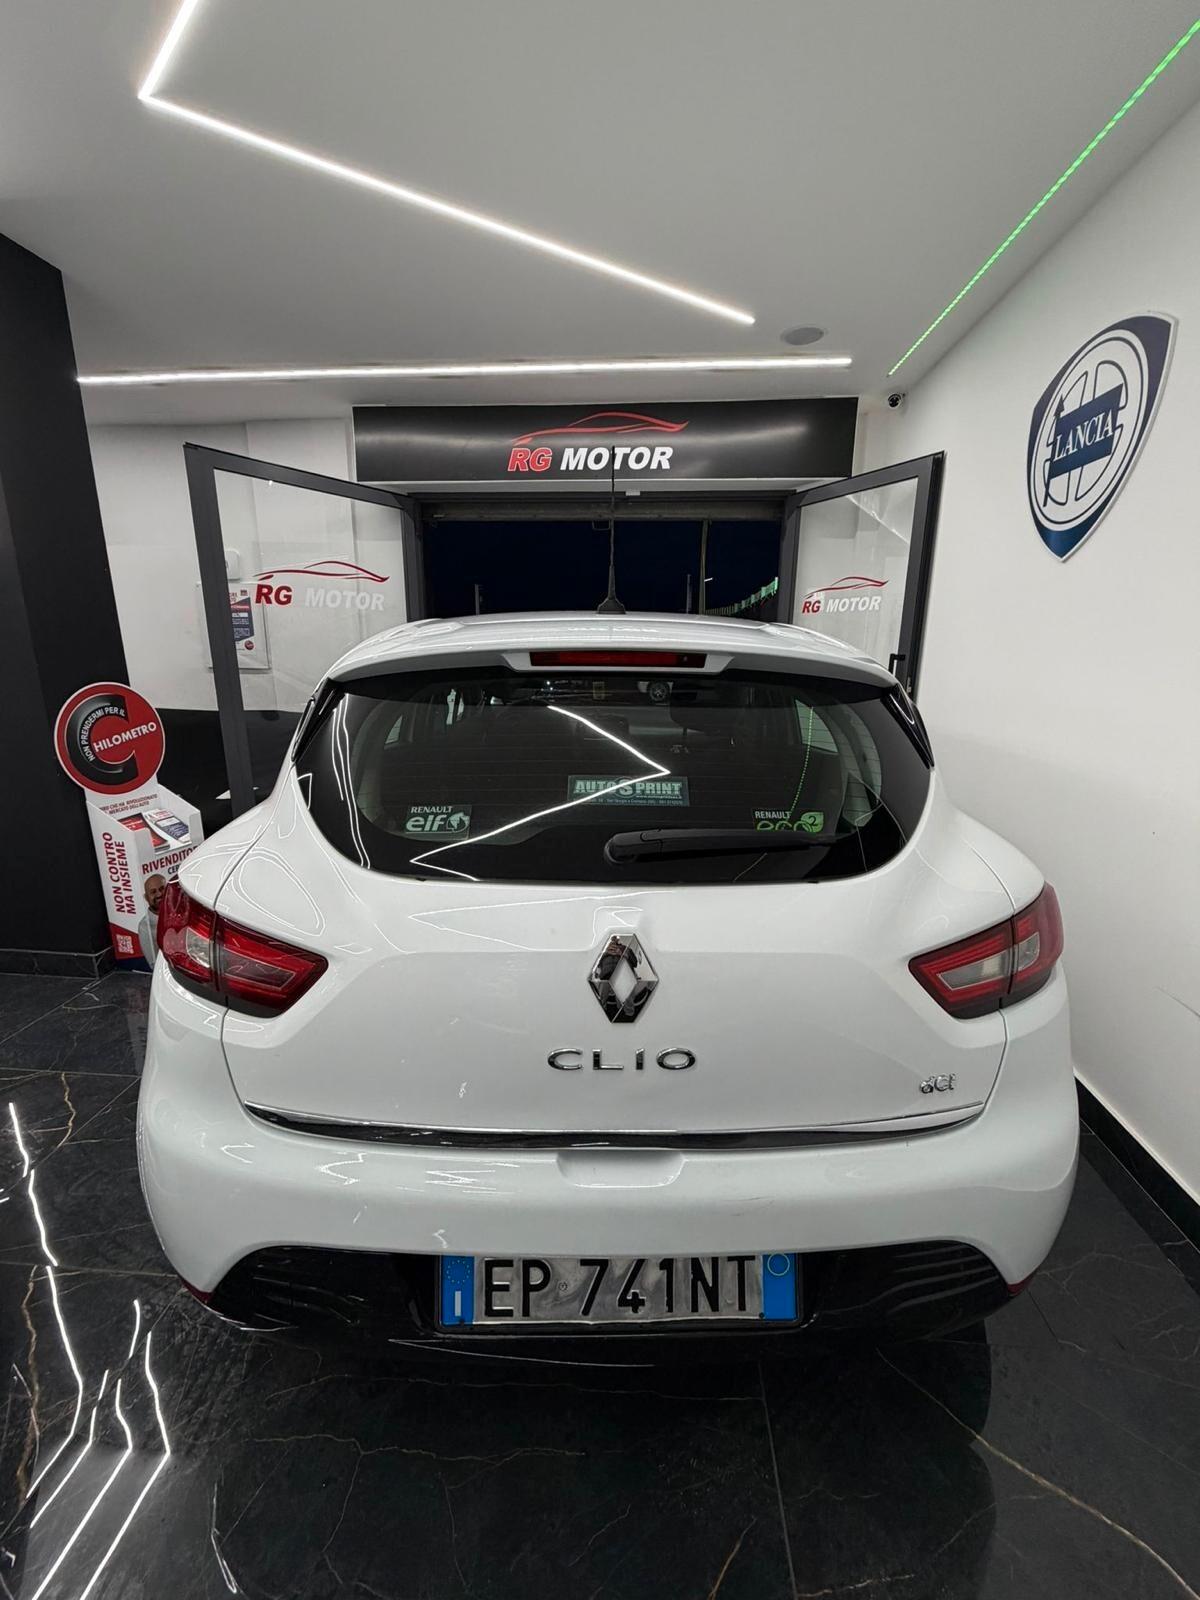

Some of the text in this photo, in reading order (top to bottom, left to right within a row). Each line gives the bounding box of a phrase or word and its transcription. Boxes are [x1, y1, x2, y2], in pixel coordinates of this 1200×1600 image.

[1053, 409, 1113, 462] LANCIA
[508, 446, 673, 472] RG MOTOR
[255, 584, 293, 606] RG
[304, 587, 385, 611] MOTOR
[802, 596, 881, 614] RG MOTOR
[104, 706, 118, 714] PER
[81, 710, 105, 745] PRENDERMI
[93, 722, 157, 752] HILOMETRO
[83, 745, 96, 762] NON
[406, 815, 447, 831] elf
[410, 806, 453, 814] RENAULT
[755, 811, 792, 819] RENAULT
[102, 832, 126, 913] NON CONTRO
[115, 841, 137, 914] MA INSIEME
[548, 1048, 696, 1070] CLIO
[484, 1258, 551, 1318] EP
